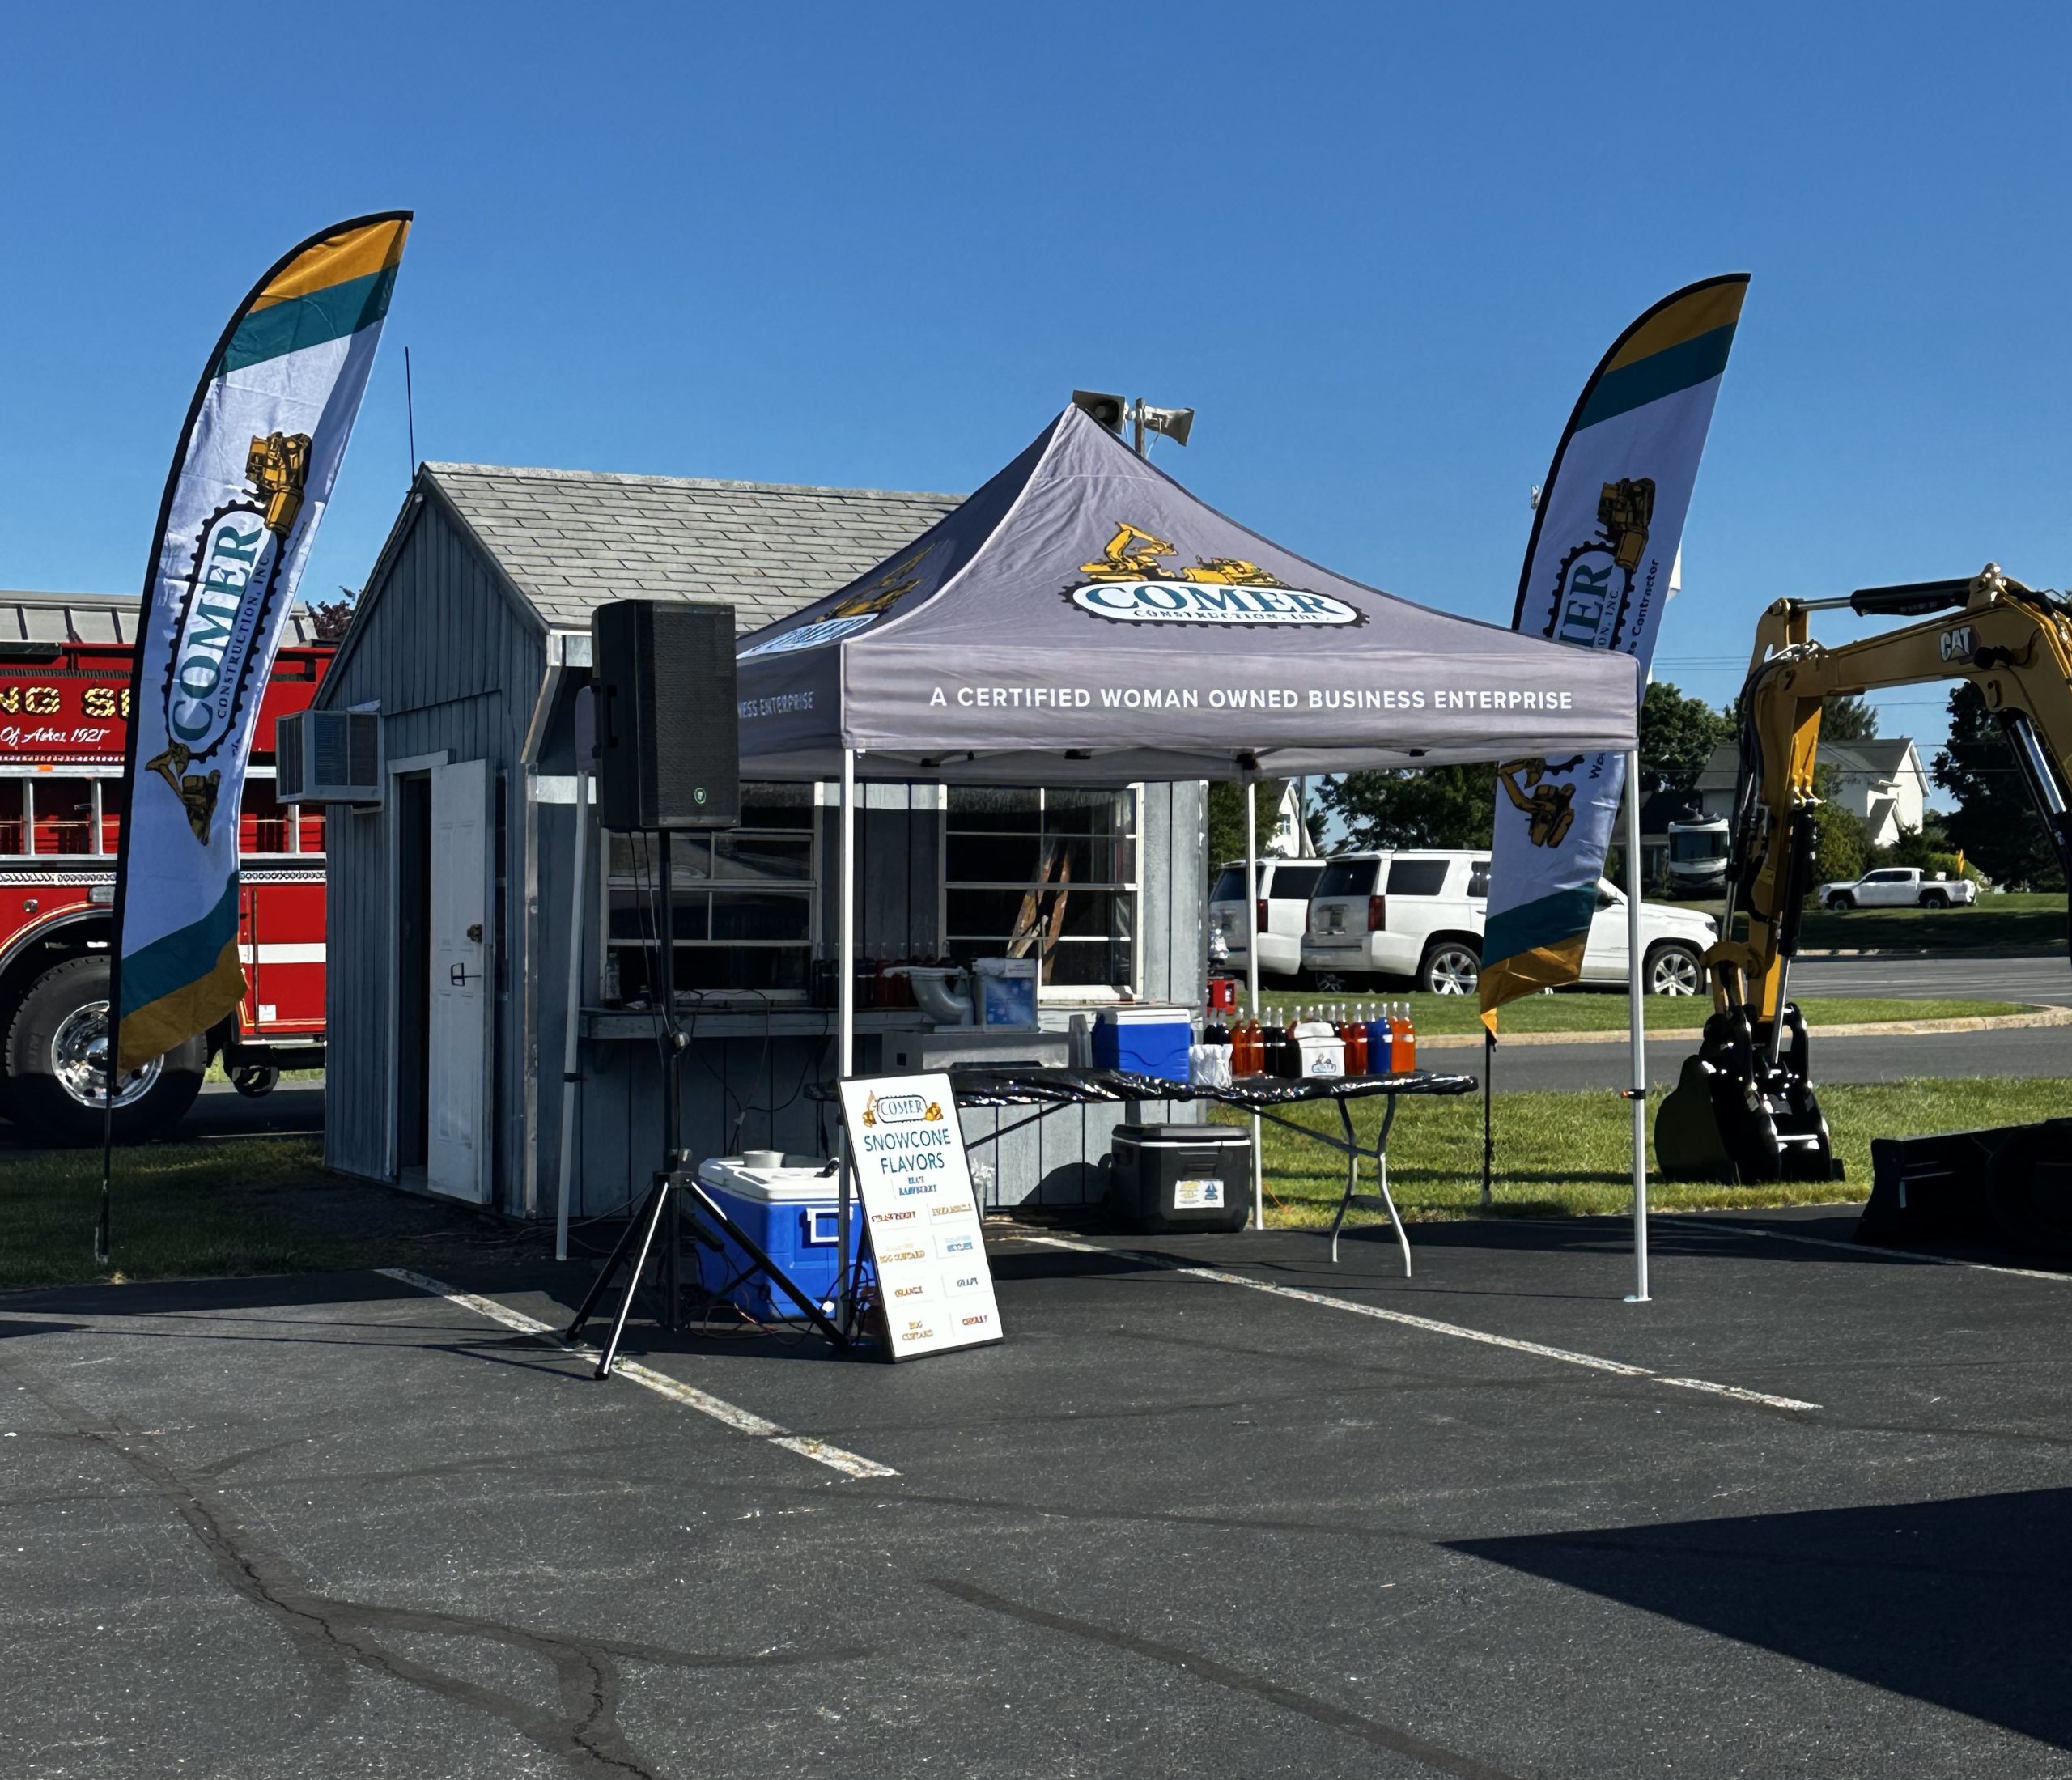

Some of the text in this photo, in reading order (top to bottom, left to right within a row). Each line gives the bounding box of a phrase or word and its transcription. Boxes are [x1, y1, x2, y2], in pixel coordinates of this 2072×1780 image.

[1085, 584, 1345, 615] COMER
[1631, 559, 1659, 637] Contractor
[172, 525, 264, 742] COMER
[1940, 626, 1972, 662] CAT
[759, 690, 815, 716] ENTERPRISE
[929, 686, 1573, 710] A CERTIFIED WOMAN OWNED BUSINESS ENTERPRISE
[864, 1128, 952, 1152] SNOWCONE
[880, 1152, 945, 1175] FLAVORS
